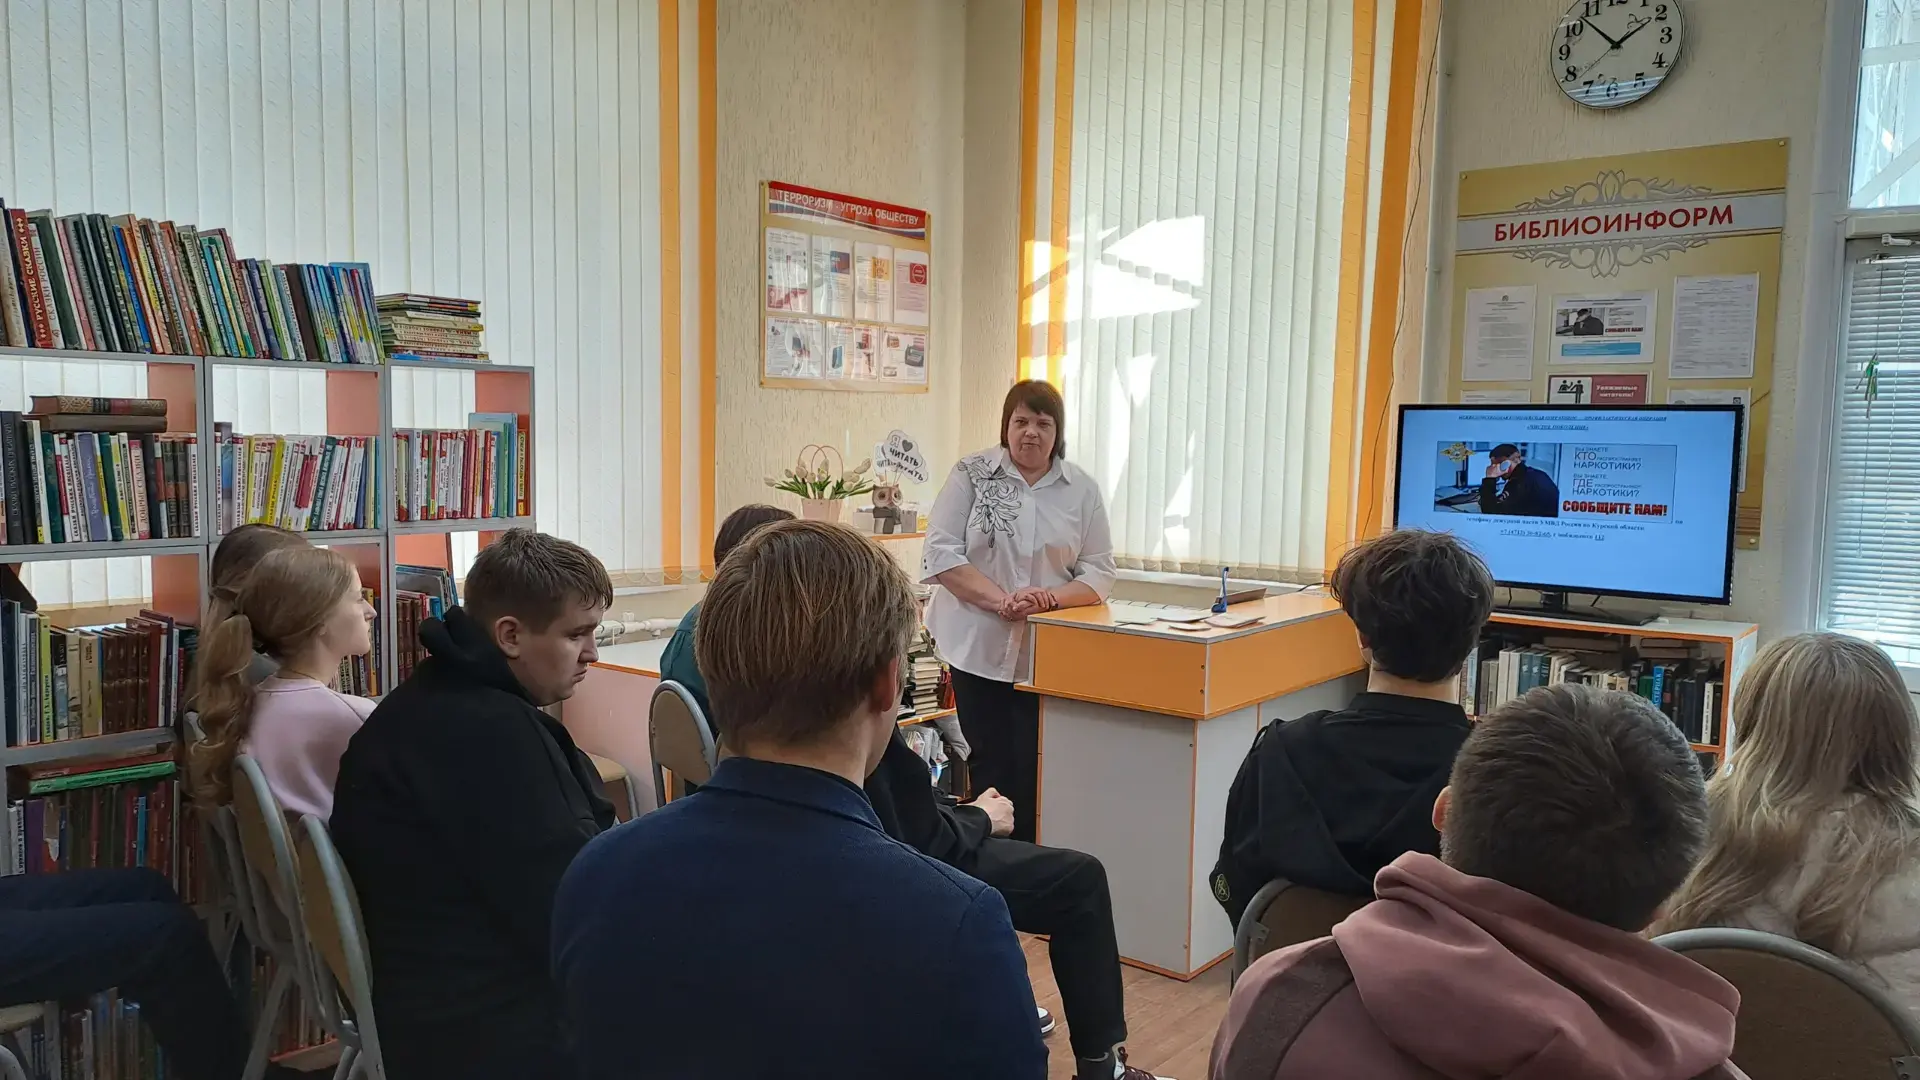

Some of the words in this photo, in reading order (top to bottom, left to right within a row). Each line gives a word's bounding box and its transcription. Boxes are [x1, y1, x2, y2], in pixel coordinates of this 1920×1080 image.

[1583, 0, 1601, 18] 11
[1655, 4, 1668, 22] 2
[1564, 18, 1584, 38] 10
[1660, 26, 1672, 44] 3
[1558, 44, 1570, 61] 9
[1652, 52, 1666, 69] 4
[1565, 65, 1577, 82] 8
[1634, 72, 1646, 88] 5
[1582, 79, 1594, 96] 7
[1606, 81, 1619, 98] 6
[778, 190, 833, 210] ТЕРРОРИЗМ
[840, 201, 873, 216] УГРОЗА
[875, 208, 919, 225] ОБЩЕСТВУ
[1495, 204, 1734, 241] БИБЛИОИНФОРМ
[19, 236, 34, 275] СКАЗКИ
[34, 247, 47, 282] РОССИИ
[28, 278, 43, 321] РУССКИЕ
[43, 286, 56, 321] СКАЗКИ
[890, 434, 900, 448] Я
[889, 447, 919, 467] ЧИТАТЬ
[1574, 451, 1597, 460] КТО
[134, 454, 143, 488] СКАЗКИ
[1573, 461, 1642, 470] НАРКОТИКИ?
[1573, 478, 1593, 488] ГДЕ
[1572, 488, 1640, 498] НАРКОТИКИ?
[139, 490, 148, 524] ДОБРЫЕ
[1562, 500, 1632, 515] СООБЩИТЕ
[1634, 503, 1668, 516] НАМ!
[1592, 522, 1619, 530] Курской
[1654, 672, 1662, 703] СТЕРНАК
